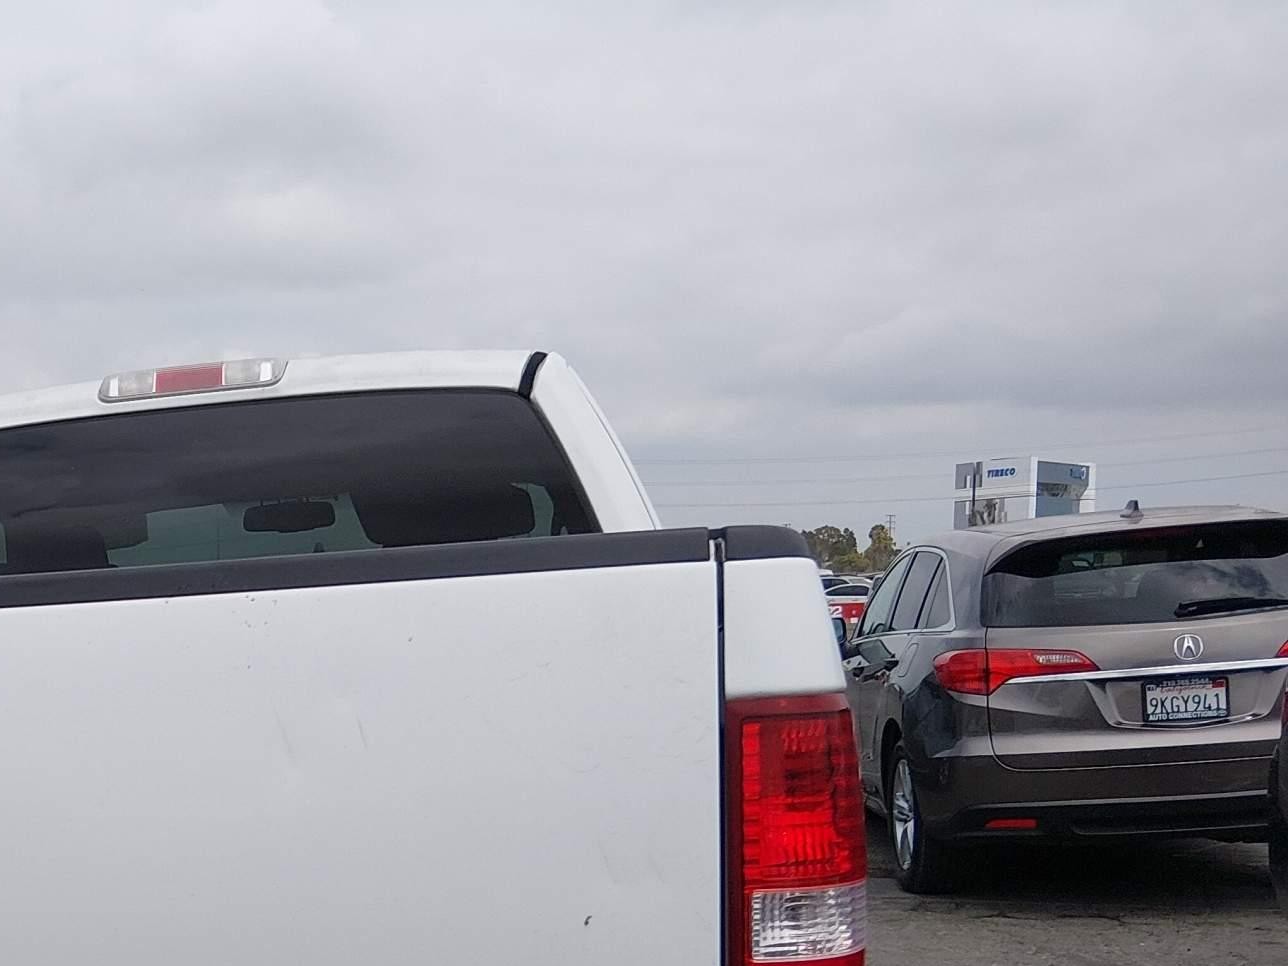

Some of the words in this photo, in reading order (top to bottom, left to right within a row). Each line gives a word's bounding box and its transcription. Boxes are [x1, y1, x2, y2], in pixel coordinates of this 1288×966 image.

[986, 467, 1016, 478] TIRECO
[1149, 693, 1221, 714] 9KGY941
[1148, 713, 1168, 721] AUTO
